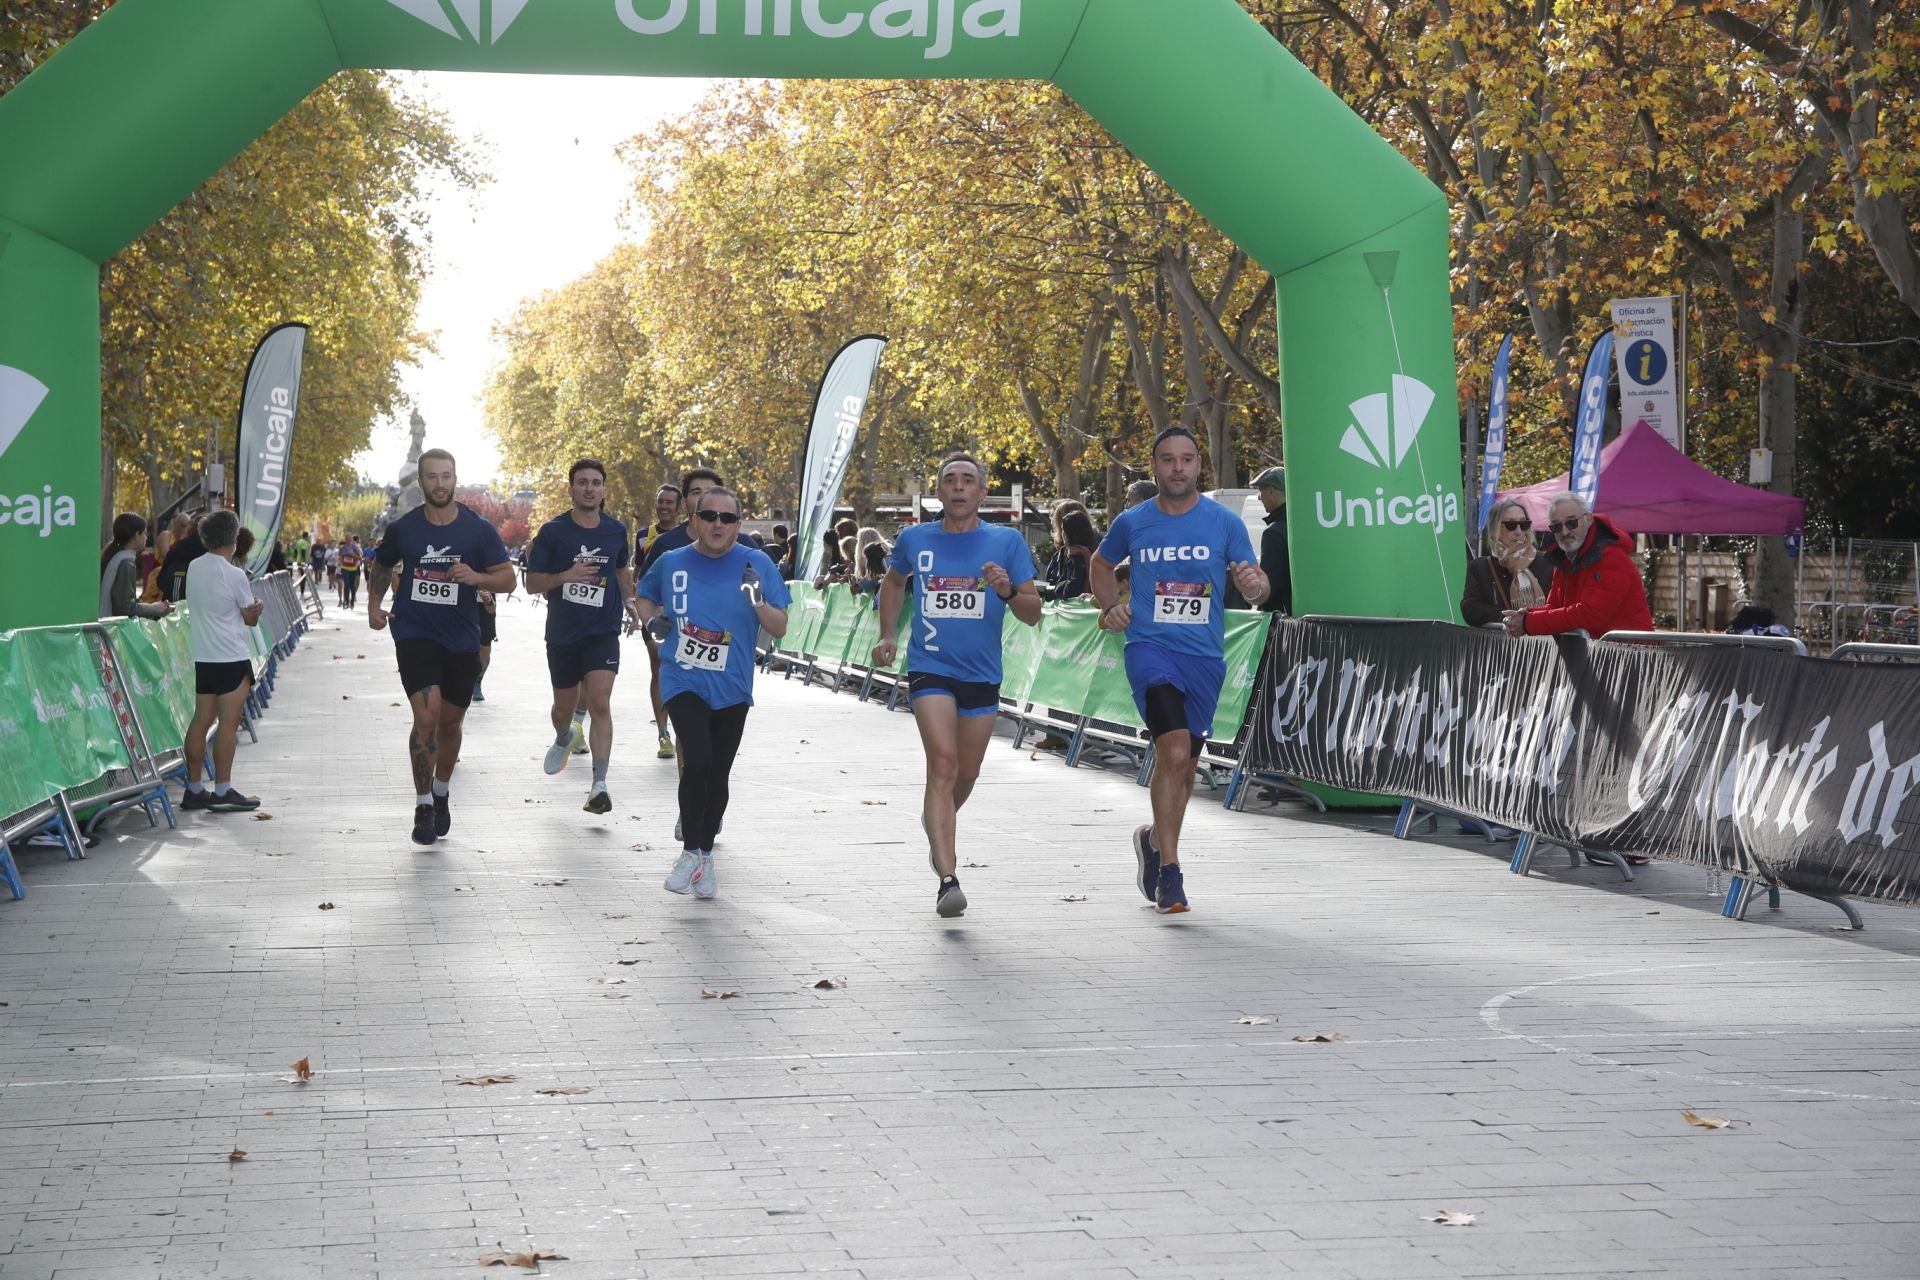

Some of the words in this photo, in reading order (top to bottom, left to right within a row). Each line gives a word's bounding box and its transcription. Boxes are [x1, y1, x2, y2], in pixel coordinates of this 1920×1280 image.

[1618, 307, 1645, 316] Oficina
[1646, 306, 1656, 314] de
[1620, 317, 1665, 326] Iormación
[255, 386, 294, 507] Unicaja
[1315, 483, 1458, 535] Unicaja
[573, 556, 609, 564] MCHLIN
[1140, 545, 1210, 563] IVECO
[418, 582, 451, 598] 696
[568, 584, 599, 600] 697
[935, 592, 976, 610] 580
[1162, 597, 1202, 616] 579
[684, 638, 720, 662] 578
[1694, 687, 1840, 838] Norte
[1837, 719, 1920, 850] de
